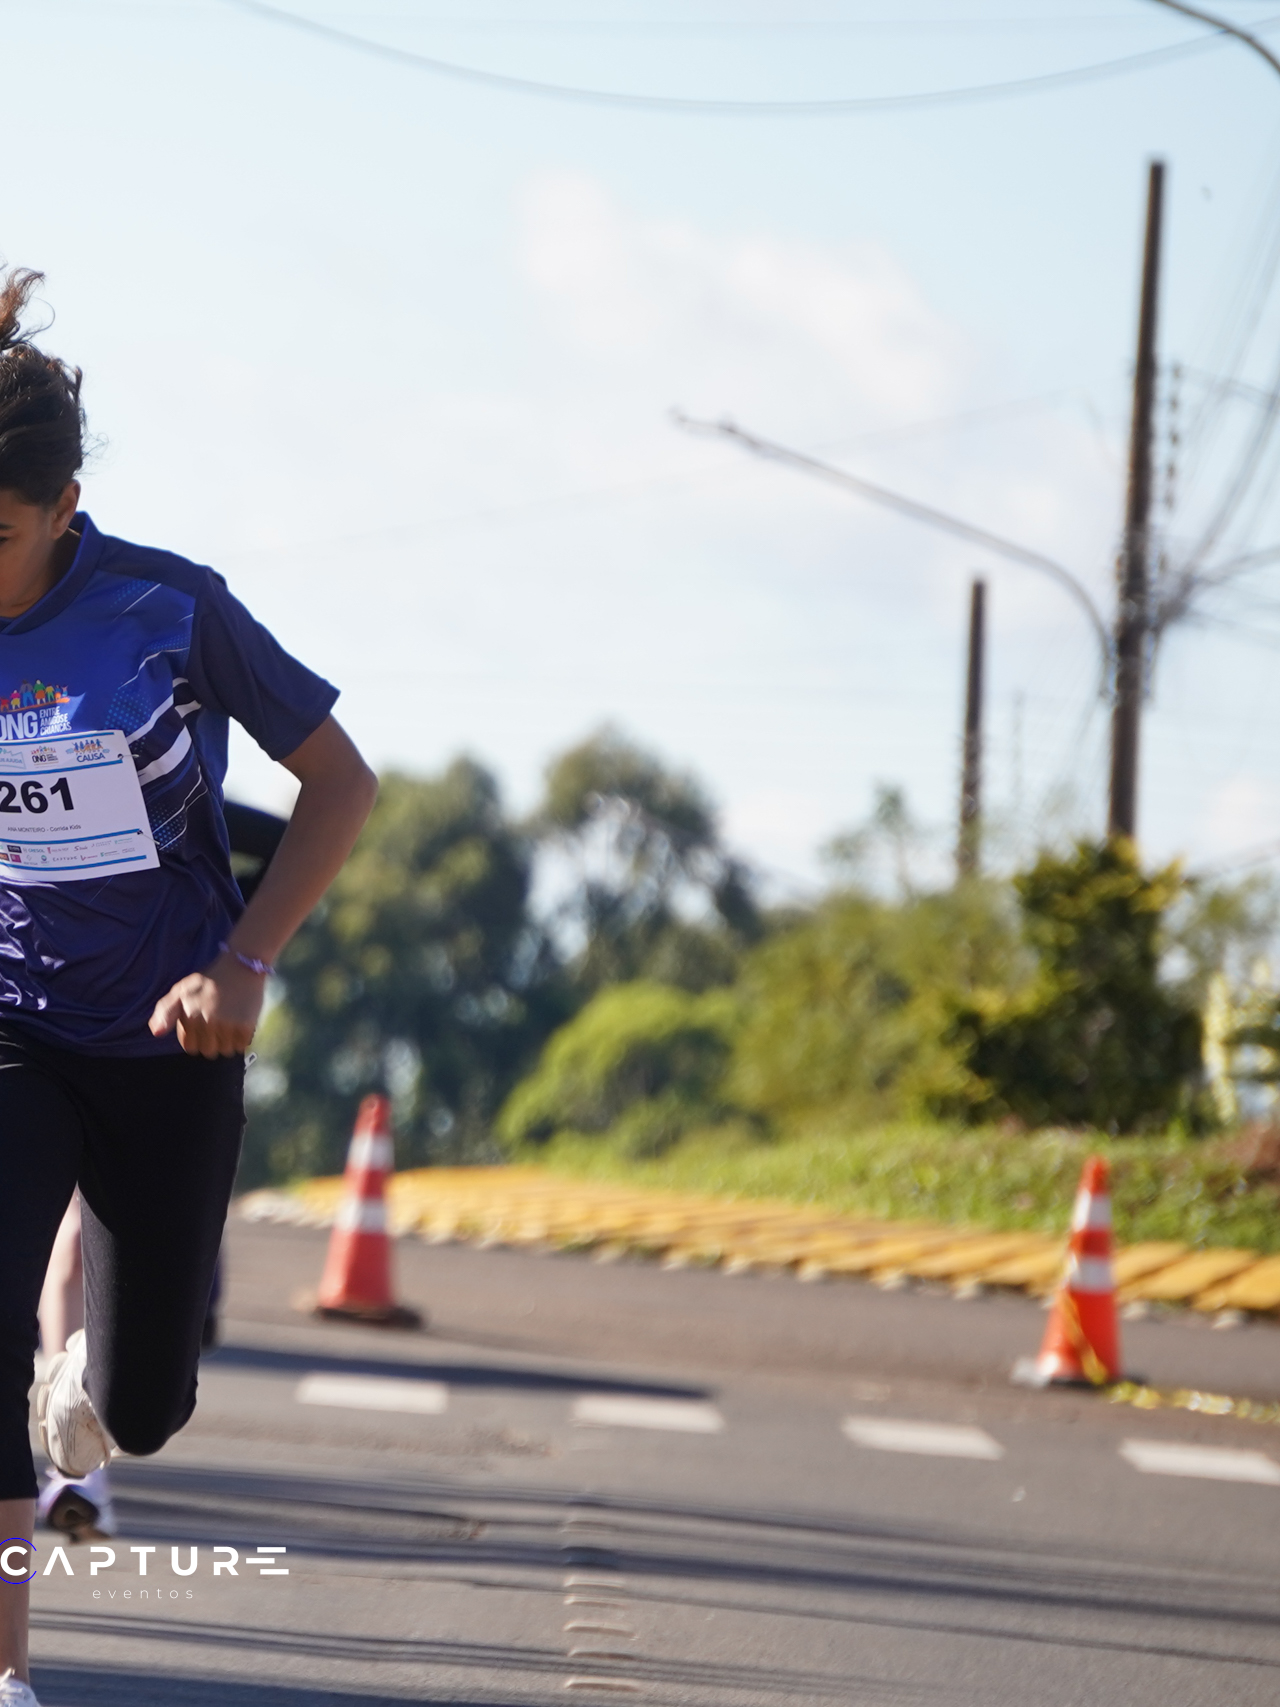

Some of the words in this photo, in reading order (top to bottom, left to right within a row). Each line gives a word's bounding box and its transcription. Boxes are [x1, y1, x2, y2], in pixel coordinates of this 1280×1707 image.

[39, 706, 61, 719] ENTRE
[31, 754, 47, 763] ONG
[76, 753, 106, 763] CAUSA
